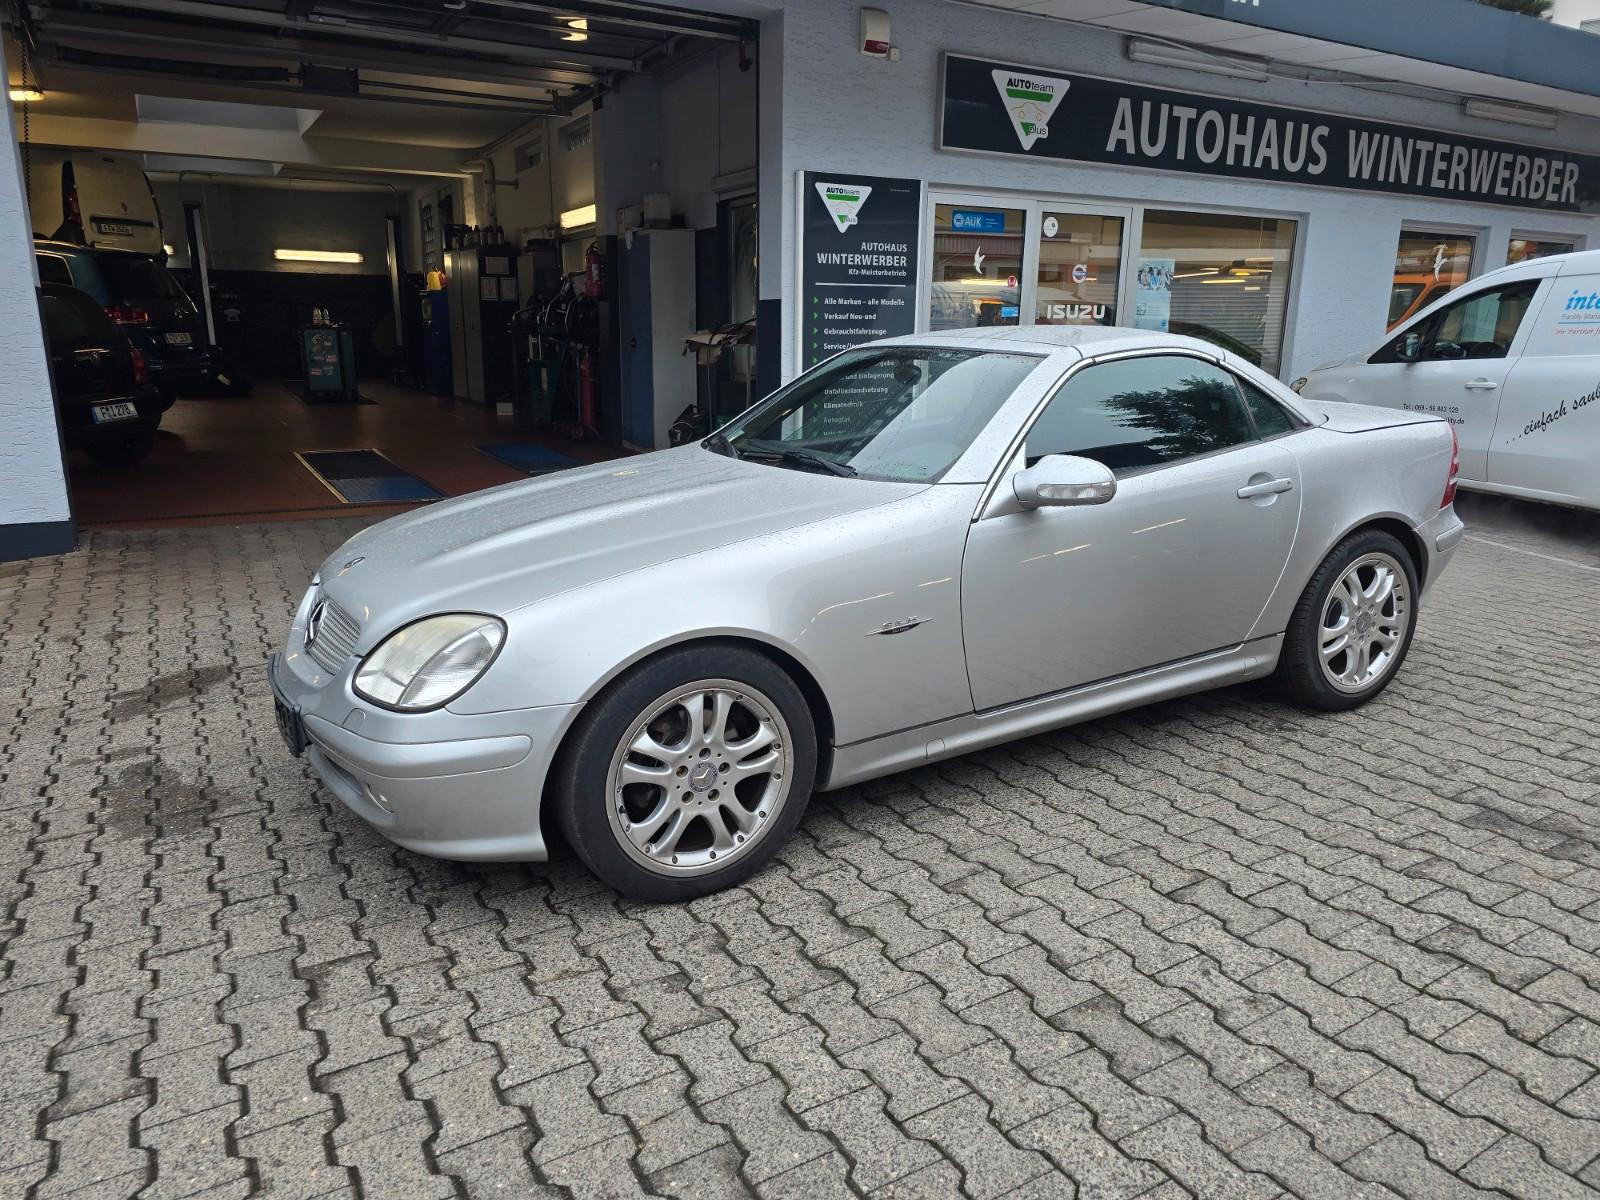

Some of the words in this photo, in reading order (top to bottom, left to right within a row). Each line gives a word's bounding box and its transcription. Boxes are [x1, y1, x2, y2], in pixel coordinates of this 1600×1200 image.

[1007, 77, 1053, 93] AUTOteam
[1105, 97, 1330, 175] AUTOHAUS
[1348, 129, 1580, 203] WINTERWERBER
[861, 242, 908, 252] AUTOHAUS
[817, 253, 907, 267] WINTERWERBER
[848, 269, 907, 277] Kfz-Meisterbetrieb
[1047, 305, 1105, 319] ISUZU
